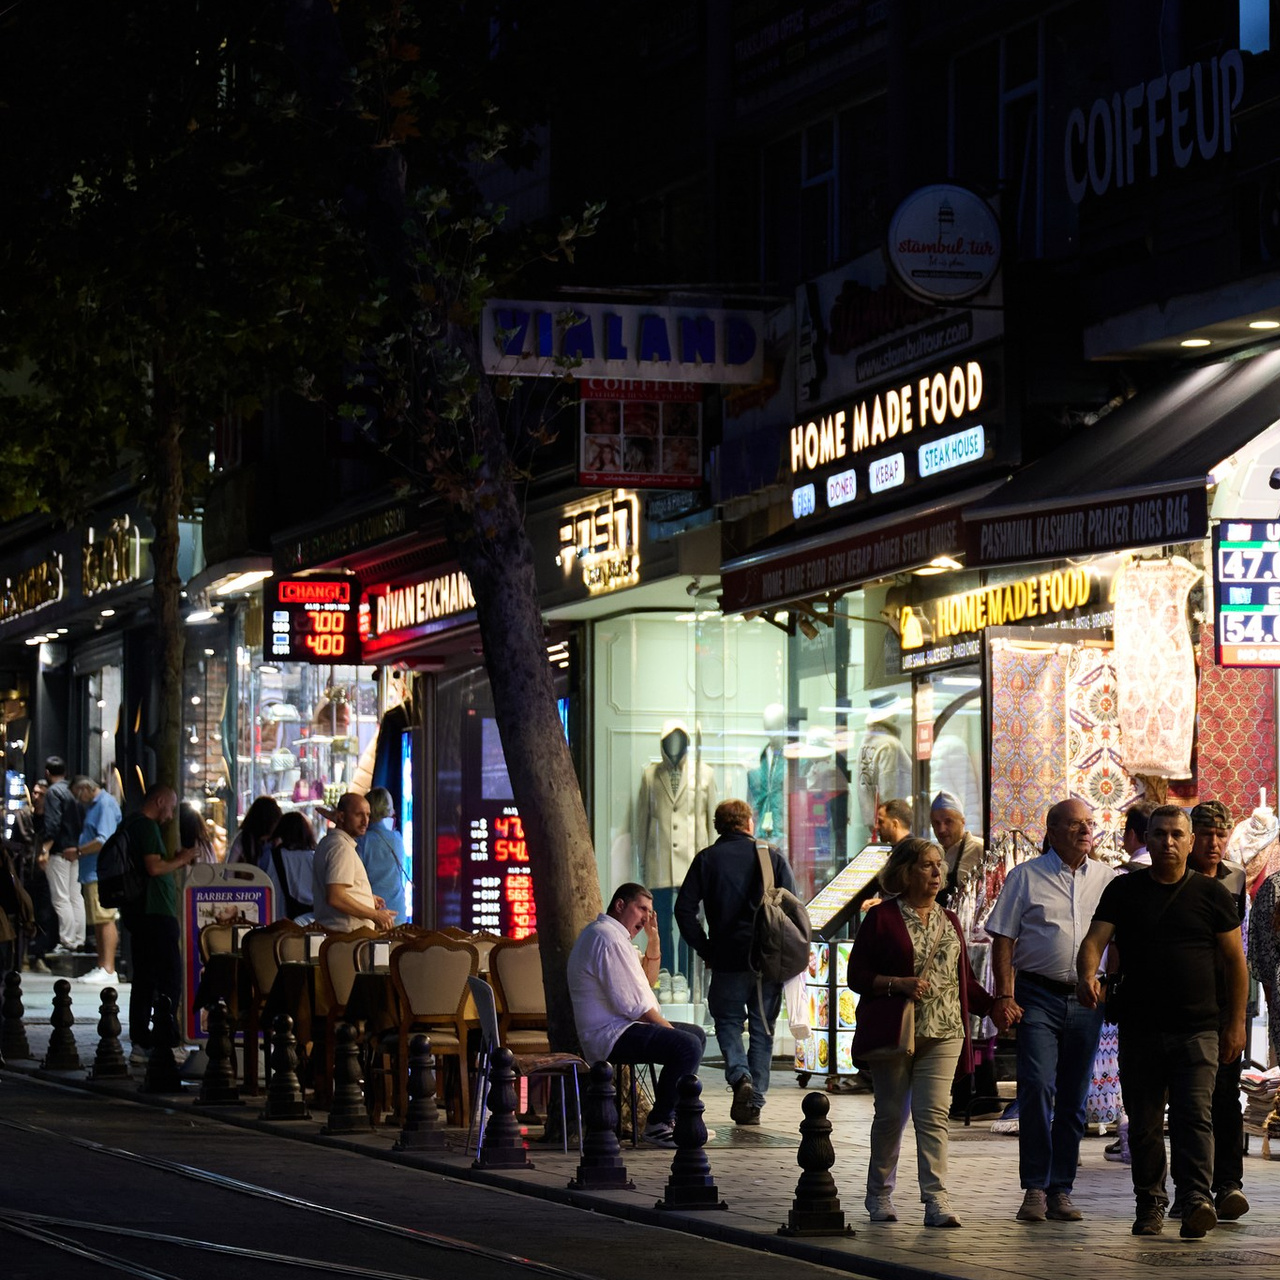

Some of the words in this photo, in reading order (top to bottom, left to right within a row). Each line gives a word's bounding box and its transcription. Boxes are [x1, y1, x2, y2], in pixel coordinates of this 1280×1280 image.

[494, 308, 757, 366] VIALAND
[789, 410, 847, 475] HOME
[851, 384, 914, 454] MADE
[918, 360, 984, 428] FOOD
[875, 460, 899, 486] KEBAP
[925, 442, 951, 471] STEAK
[951, 434, 979, 462] HOUSE
[979, 519, 1034, 560] PASHMINA
[1035, 512, 1085, 554] KASHMIR
[1087, 503, 1130, 549] PRAYER
[1131, 498, 1163, 540] RUGS
[1165, 493, 1190, 536] BAG
[761, 571, 783, 600] HOME
[784, 564, 806, 594] MADE
[806, 558, 827, 588] FOOD
[827, 551, 846, 582] FISH
[846, 544, 872, 576] KEBAP
[901, 529, 928, 563] STEAK
[928, 520, 958, 554] HOUSE
[936, 591, 987, 638] HOME
[986, 577, 1040, 626] MADE
[1040, 566, 1091, 615] FOOD
[1237, 649, 1257, 661] NO
[196, 892, 233, 901] BARBER
[235, 892, 262, 901] SHOP
